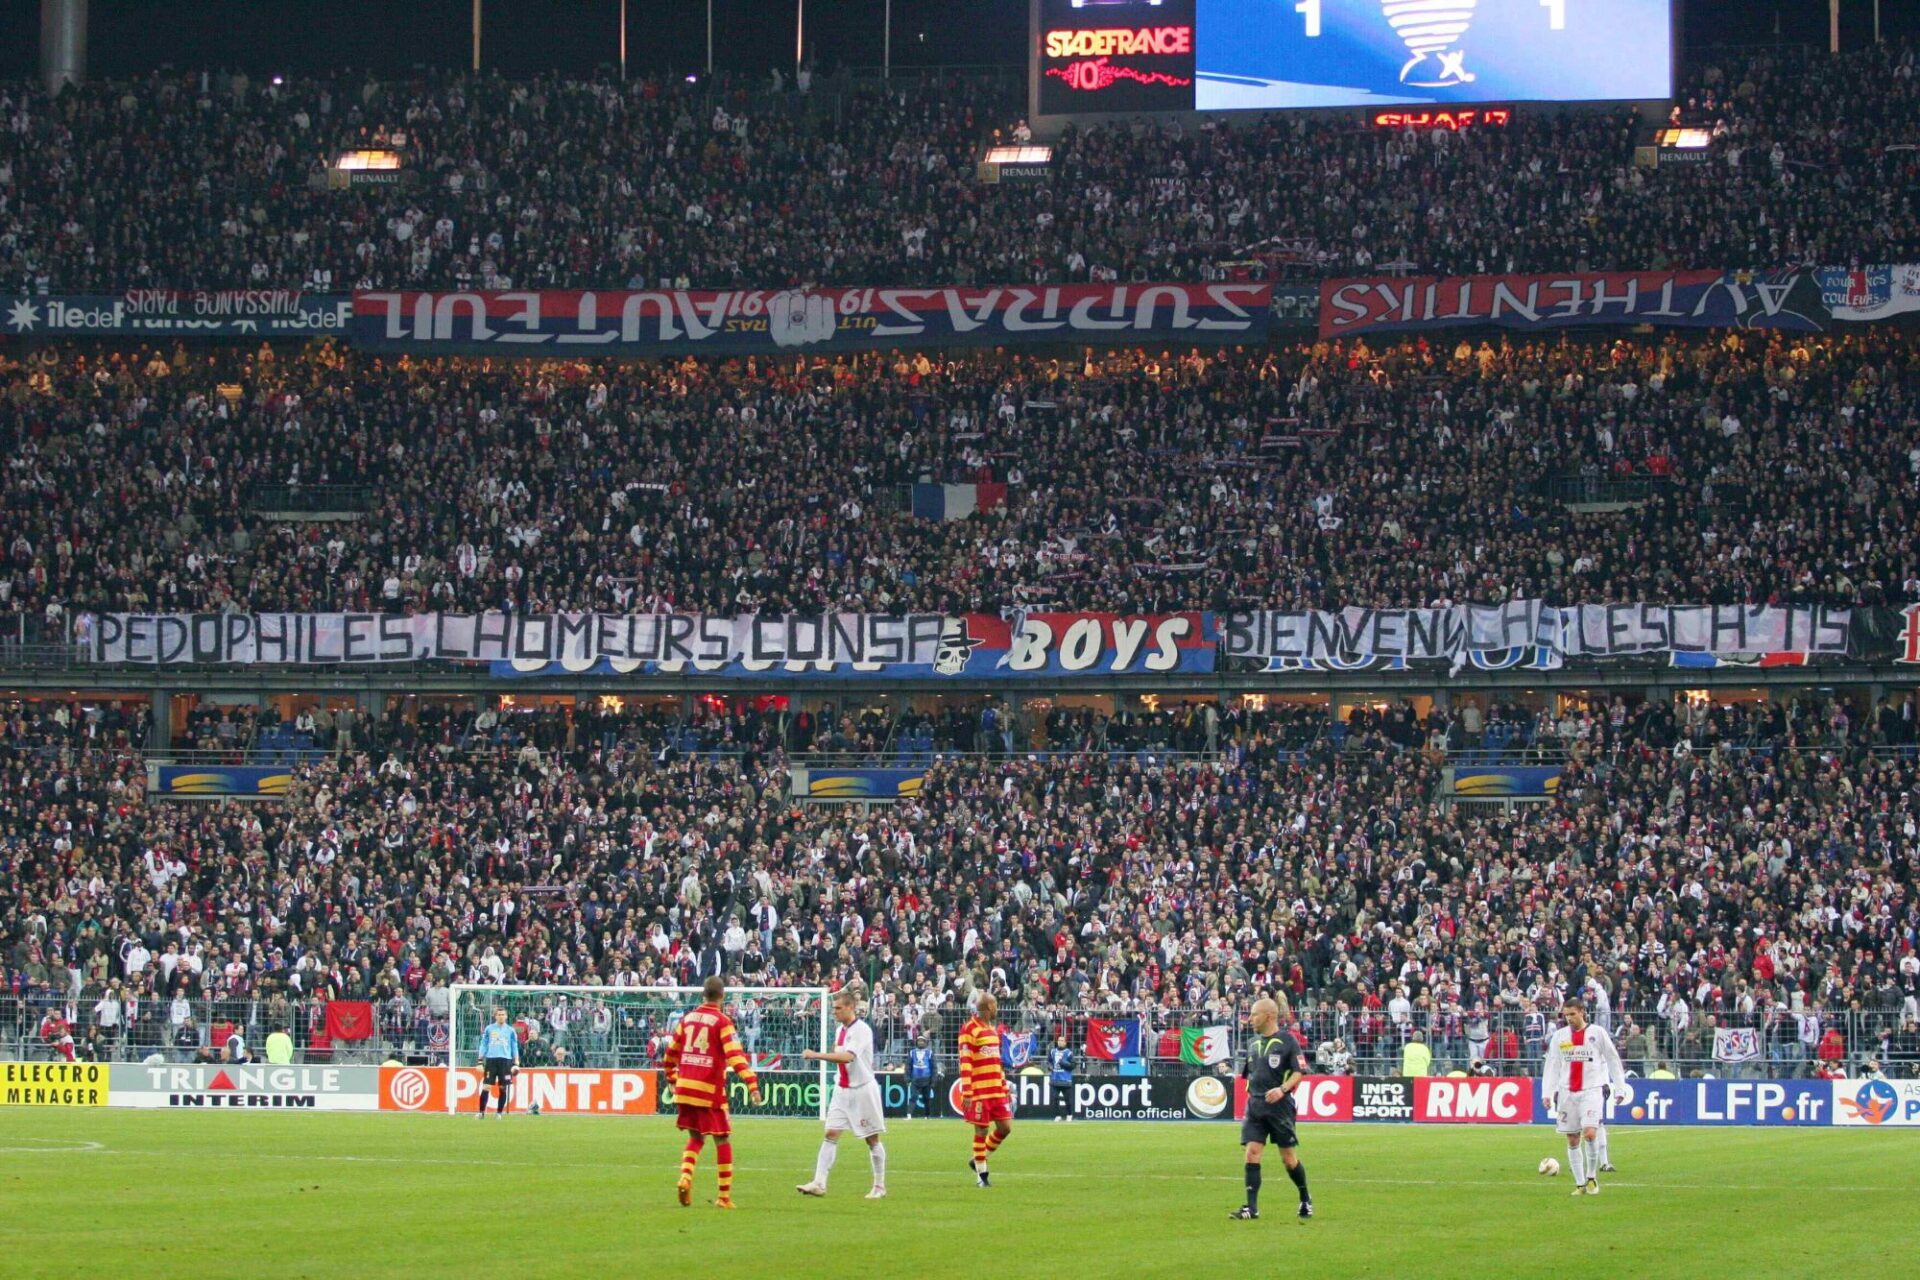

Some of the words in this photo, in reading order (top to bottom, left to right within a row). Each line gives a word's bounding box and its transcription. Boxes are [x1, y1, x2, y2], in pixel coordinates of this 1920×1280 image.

[1660, 152, 1706, 161] RENAULT
[352, 174, 400, 182] RENAULT
[1001, 167, 1048, 176] RENAULT
[1331, 273, 1800, 326] AUTHENTIKS
[356, 291, 731, 344] AUTEUIL
[871, 283, 1271, 337] SUPRAS
[1008, 617, 1191, 671] BOYS
[683, 1025, 710, 1054] 14
[7, 1064, 99, 1083] ELECTRO
[7, 1088, 98, 1105] MENAGER
[1362, 1083, 1405, 1095] INFO
[169, 1094, 316, 1107] INTERIM
[1361, 1095, 1405, 1106] TALK
[1426, 1082, 1520, 1118] RMC
[1085, 1107, 1132, 1119] ballon
[1136, 1107, 1187, 1119] officiel
[1353, 1106, 1413, 1118] SPORT
